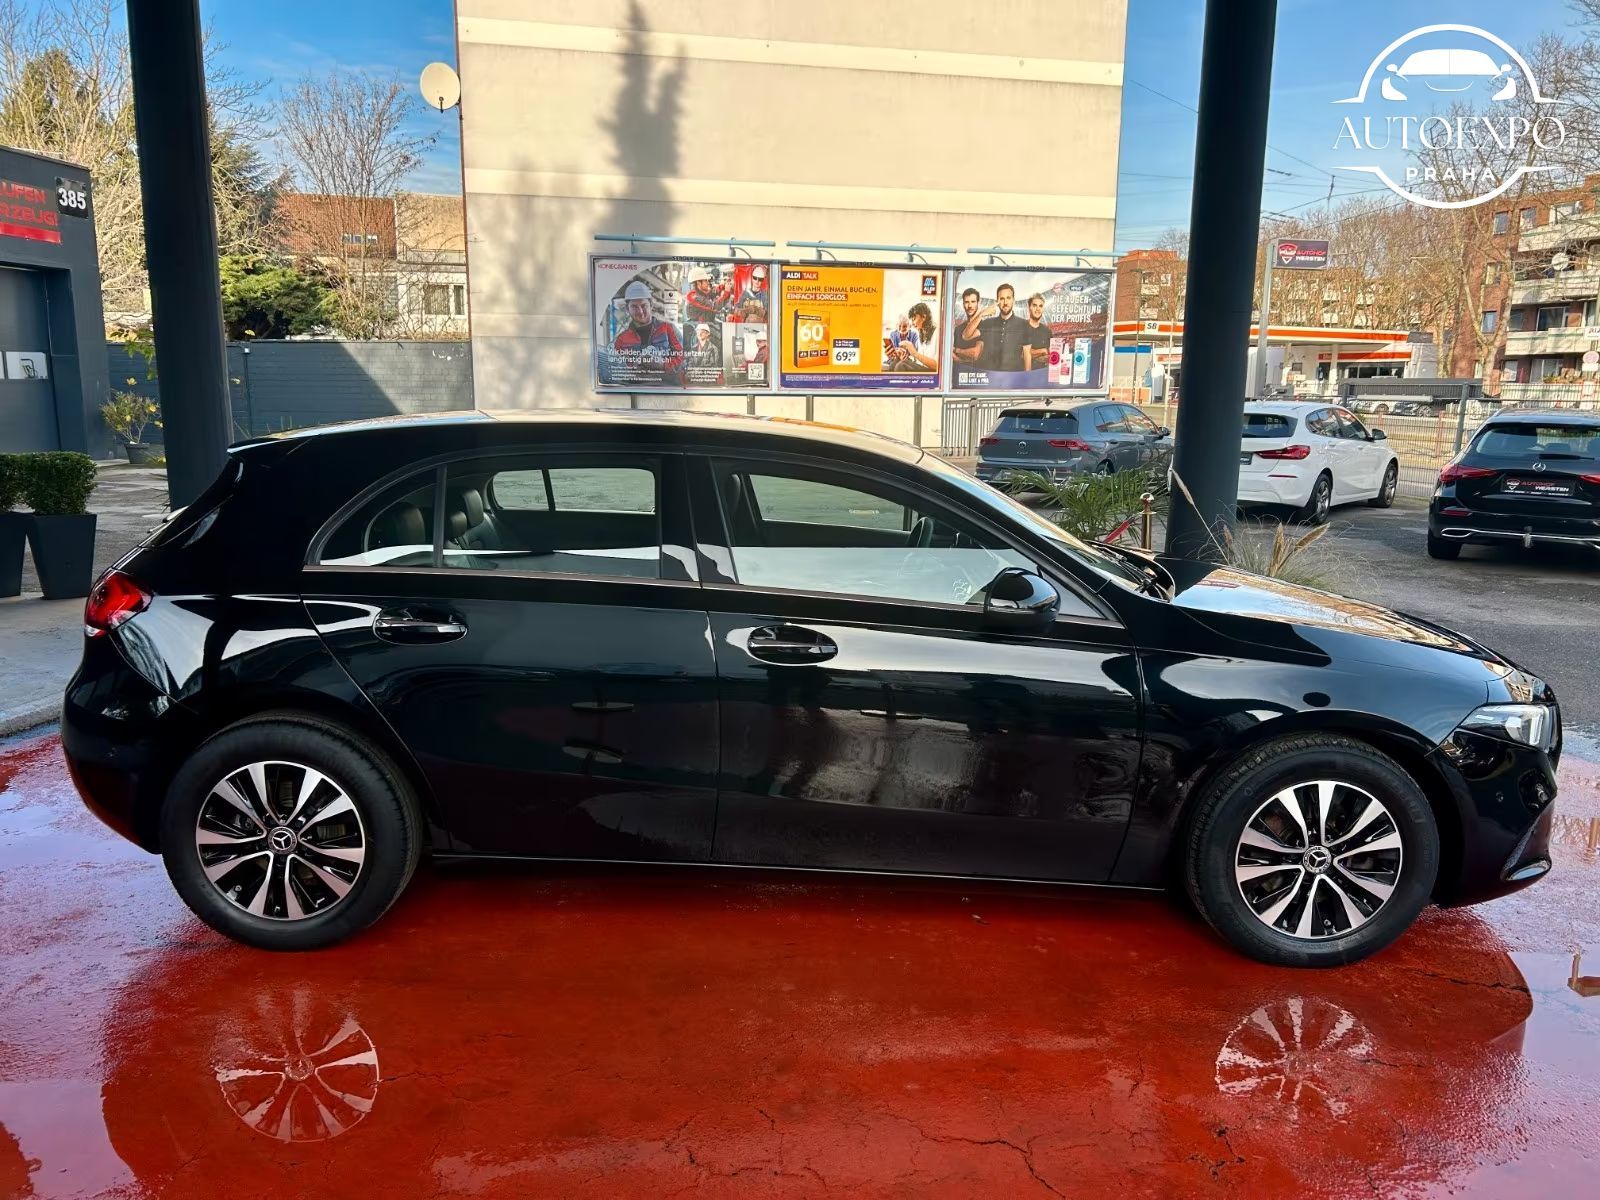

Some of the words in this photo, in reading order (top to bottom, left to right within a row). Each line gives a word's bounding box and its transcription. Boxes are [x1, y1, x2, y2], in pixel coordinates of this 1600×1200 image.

[0, 182, 46, 204] UFEN
[58, 188, 86, 210] 385
[1053, 294, 1064, 303] DIE
[1052, 304, 1102, 314] BEFEUCHTUNG
[1052, 314, 1065, 323] DER
[800, 323, 823, 342] 60
[619, 348, 641, 356] bilden
[671, 349, 683, 357] und
[608, 356, 641, 364] langfristig
